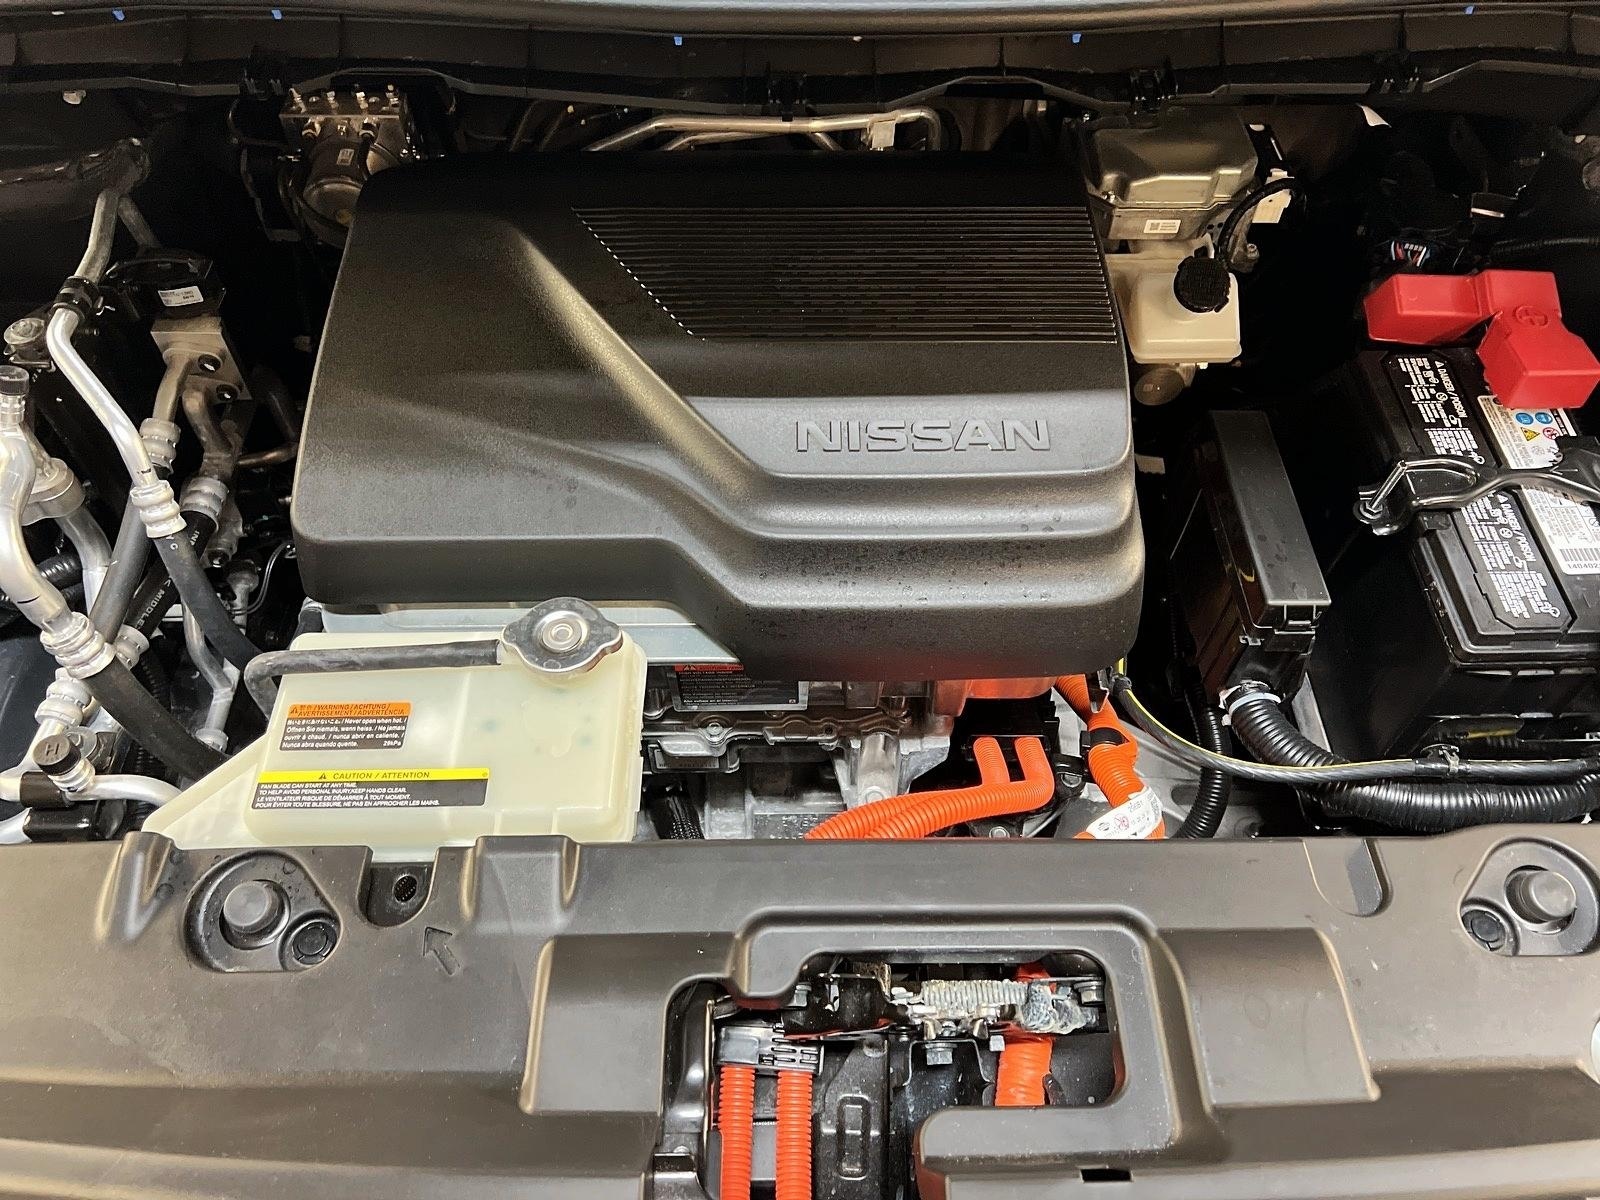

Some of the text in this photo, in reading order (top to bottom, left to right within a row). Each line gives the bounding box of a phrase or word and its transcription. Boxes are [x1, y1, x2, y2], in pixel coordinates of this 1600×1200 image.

[796, 420, 1050, 452] NISSAN
[333, 772, 372, 780] CAUTION
[381, 771, 430, 779] ATTENTION
